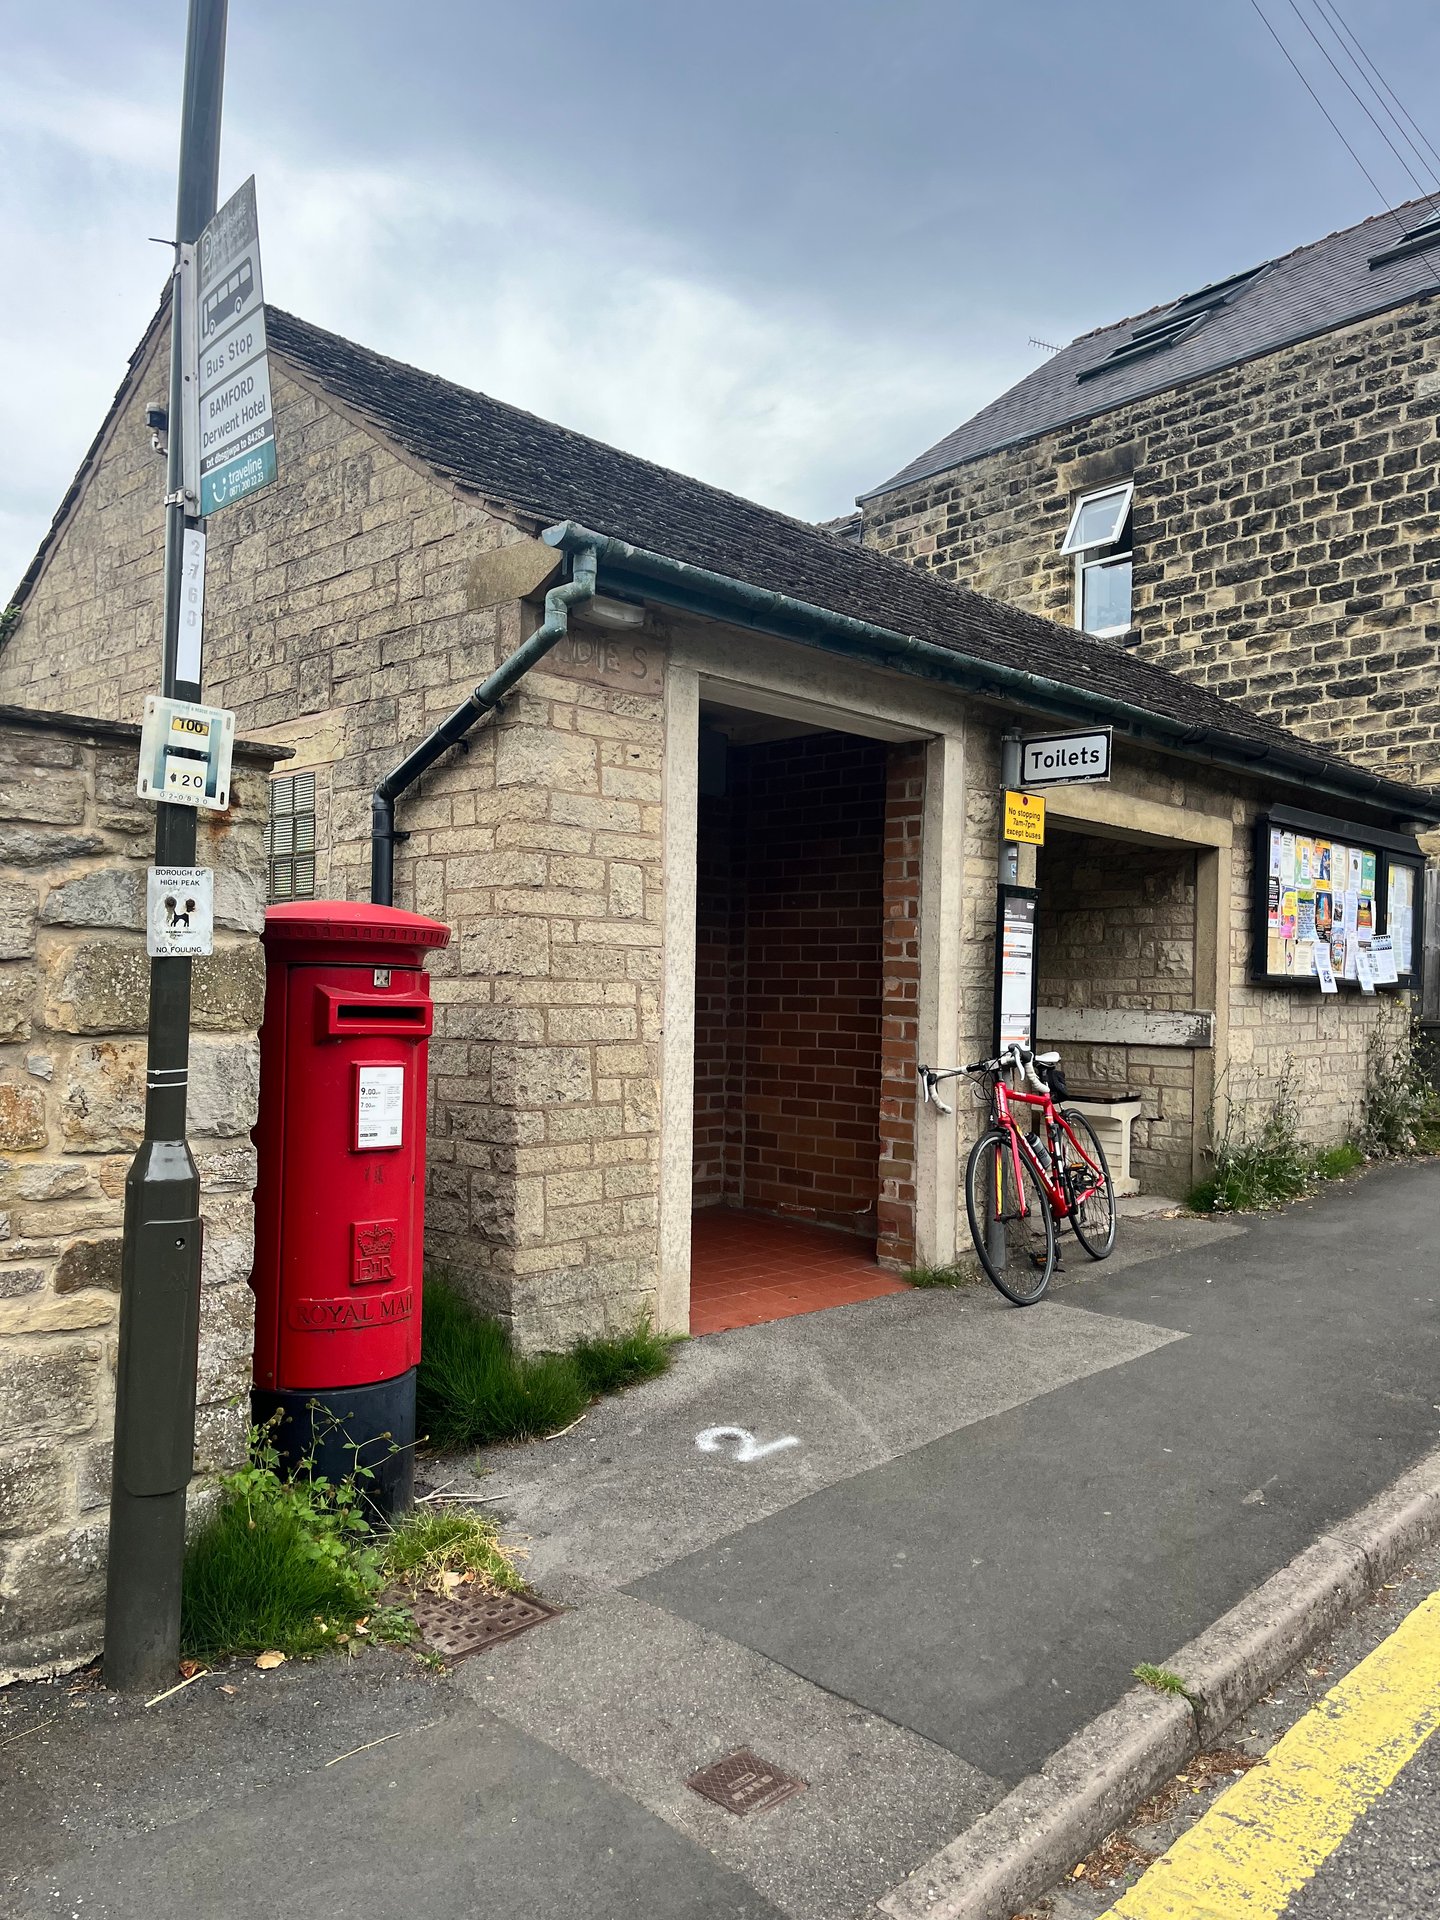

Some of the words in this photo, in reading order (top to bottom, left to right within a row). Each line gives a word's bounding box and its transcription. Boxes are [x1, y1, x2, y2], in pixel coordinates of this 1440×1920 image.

[206, 355, 224, 378] Bus
[228, 333, 252, 361] Stop
[209, 376, 254, 418] BAMFORD
[203, 413, 240, 448] Derwent
[241, 394, 266, 424] Hotel
[247, 427, 265, 445] 84268
[228, 458, 262, 485] traveline
[229, 484, 241, 497] 0871
[241, 478, 250, 491] 200
[177, 717, 203, 733] 100
[1031, 747, 1100, 769] Toilets
[182, 775, 203, 788] 20
[1008, 807, 1016, 816] No
[1018, 809, 1041, 822] stopping
[1013, 818, 1036, 829] 7am-7pm
[1006, 828, 1024, 838] except
[1025, 829, 1041, 840] buses
[297, 1303, 374, 1324] ROYAL
